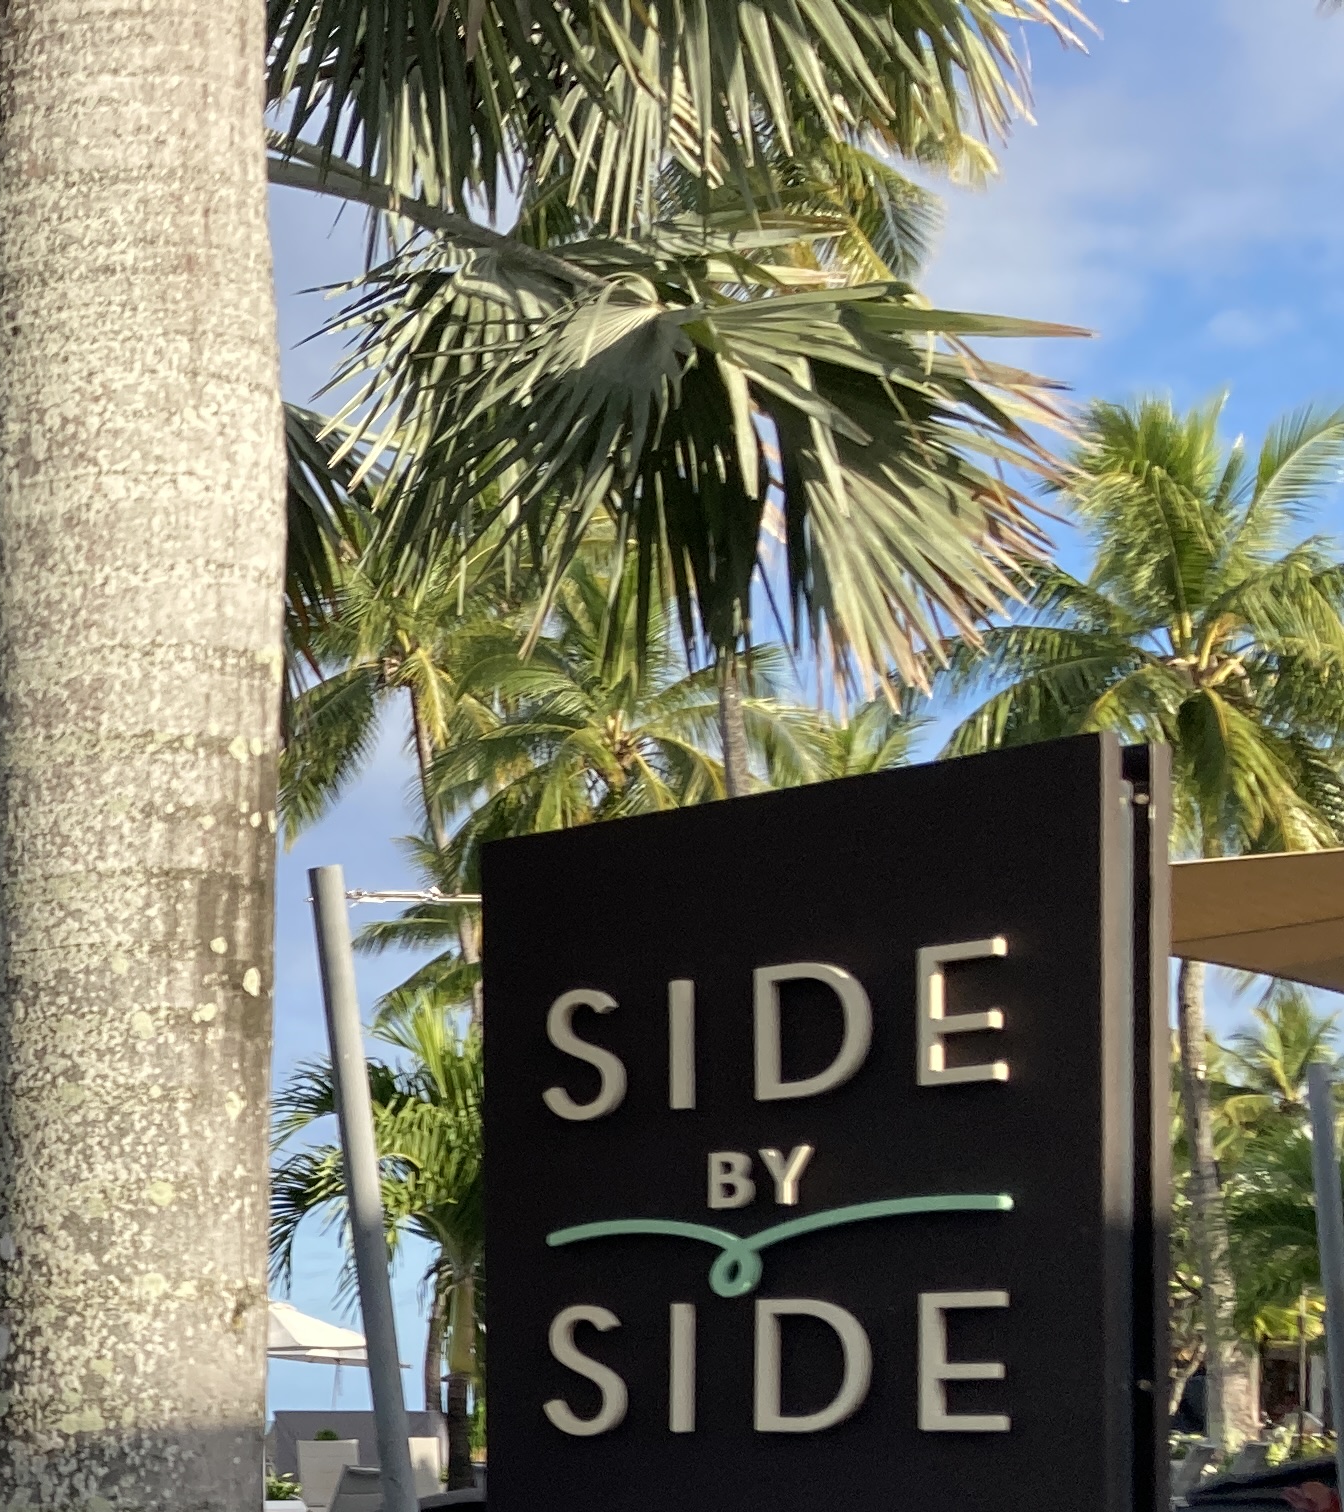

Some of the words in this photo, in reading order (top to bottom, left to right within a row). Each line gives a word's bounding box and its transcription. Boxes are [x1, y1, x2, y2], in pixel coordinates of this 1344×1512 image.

[542, 935, 1010, 1121] SIDE
[707, 1144, 813, 1209] BY
[542, 1290, 1012, 1437] SIDE
